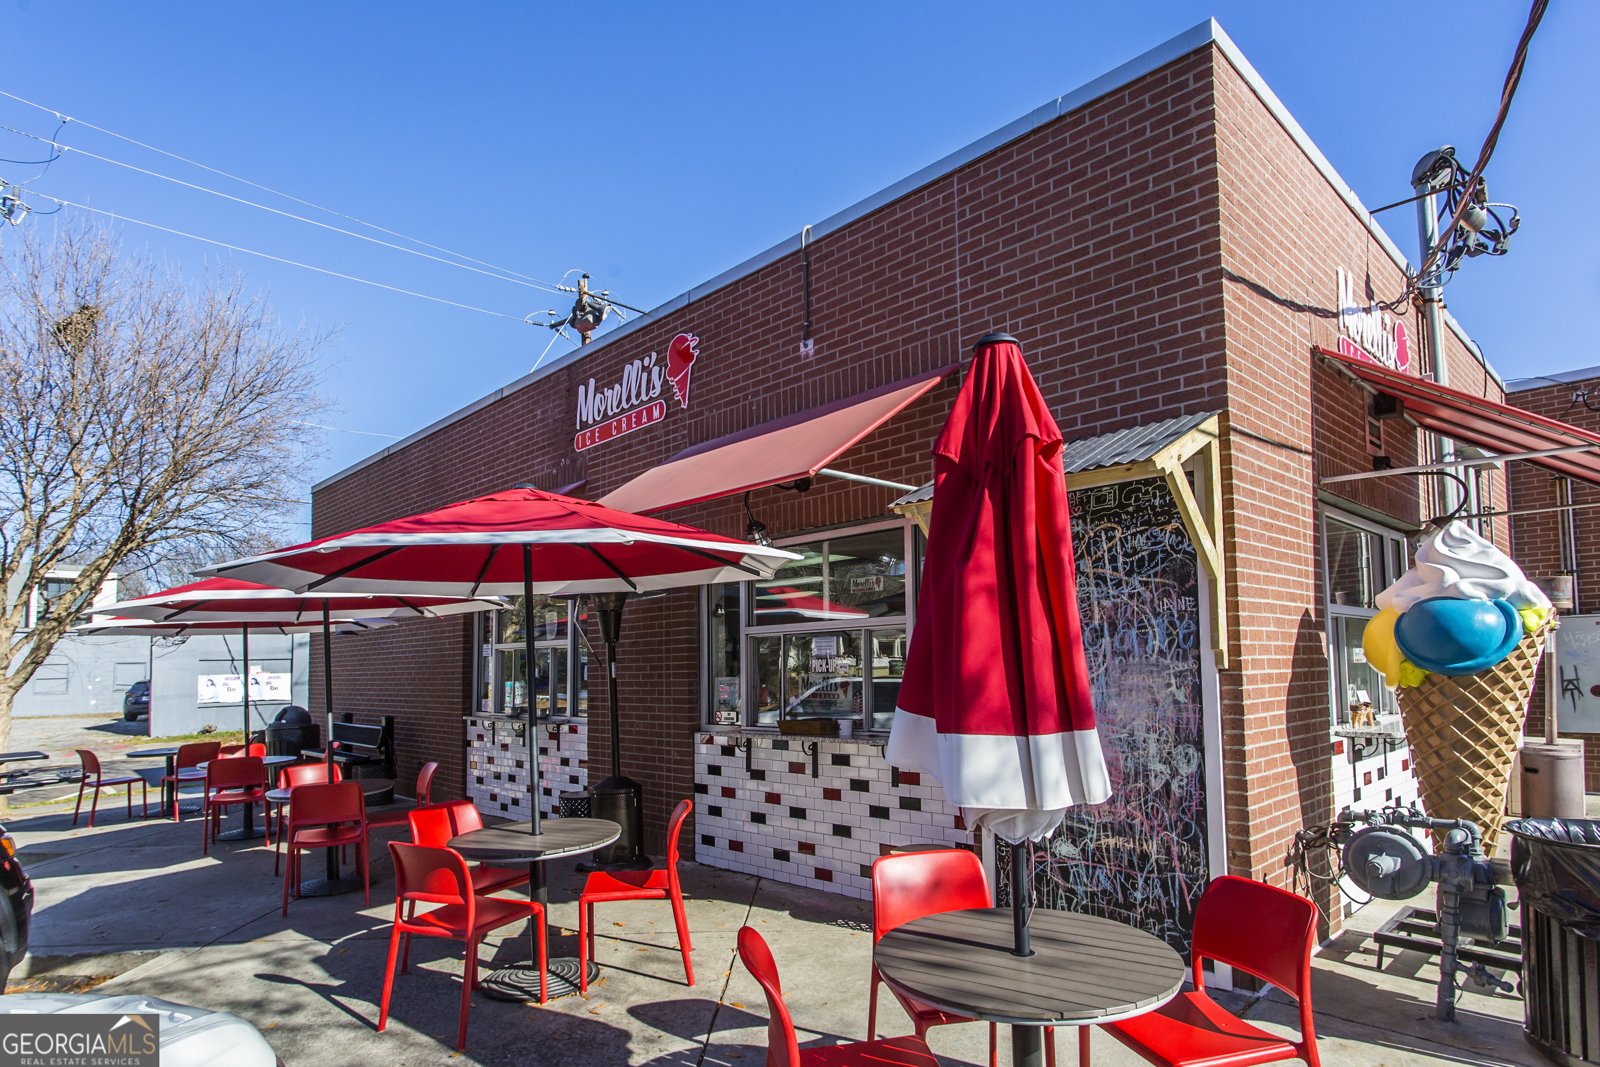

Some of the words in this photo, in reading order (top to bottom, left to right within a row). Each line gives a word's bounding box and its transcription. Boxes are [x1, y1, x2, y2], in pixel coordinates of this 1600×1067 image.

[576, 352, 664, 429] Morelli's
[612, 404, 660, 435] CREAM
[578, 428, 600, 448] ICE
